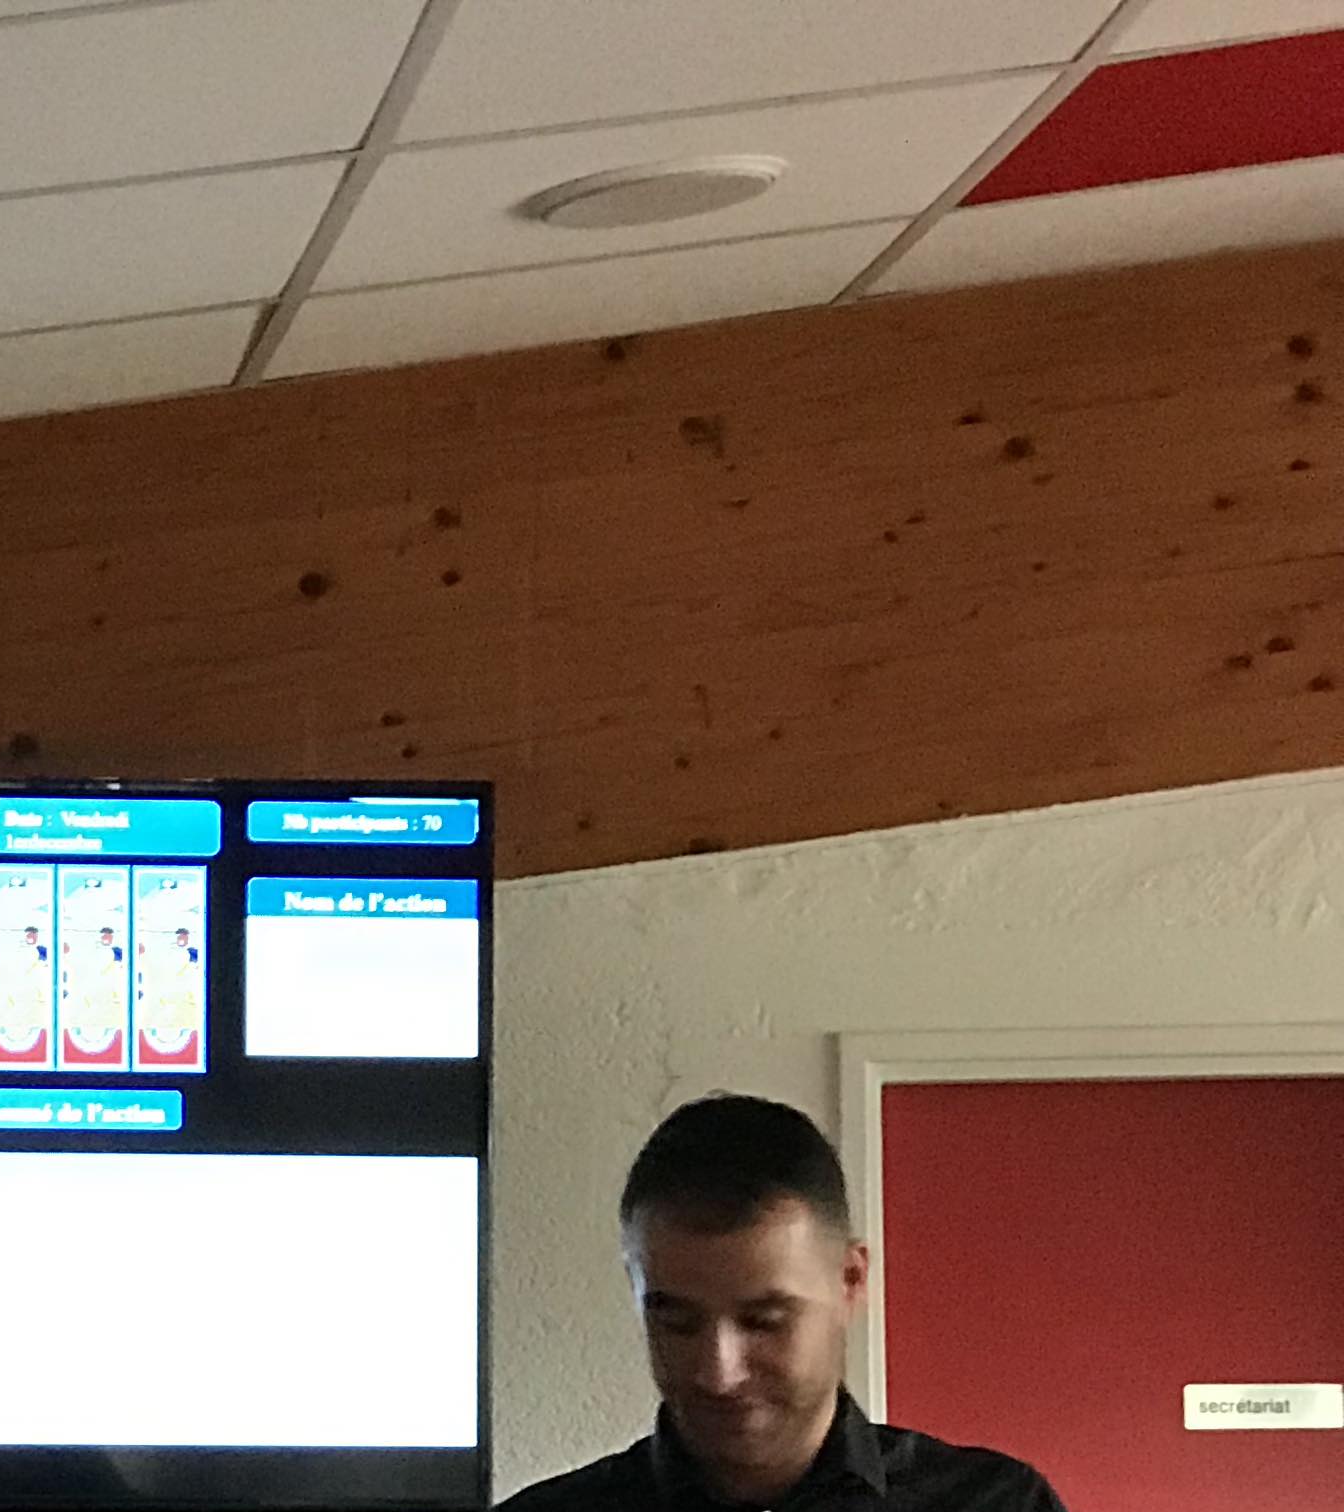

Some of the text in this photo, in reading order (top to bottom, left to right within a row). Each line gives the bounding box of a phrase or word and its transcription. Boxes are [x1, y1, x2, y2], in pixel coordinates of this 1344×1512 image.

[310, 814, 409, 834] participants
[421, 815, 443, 832] 70
[284, 891, 335, 912] Nom
[338, 893, 365, 912] de
[57, 1103, 83, 1123] de
